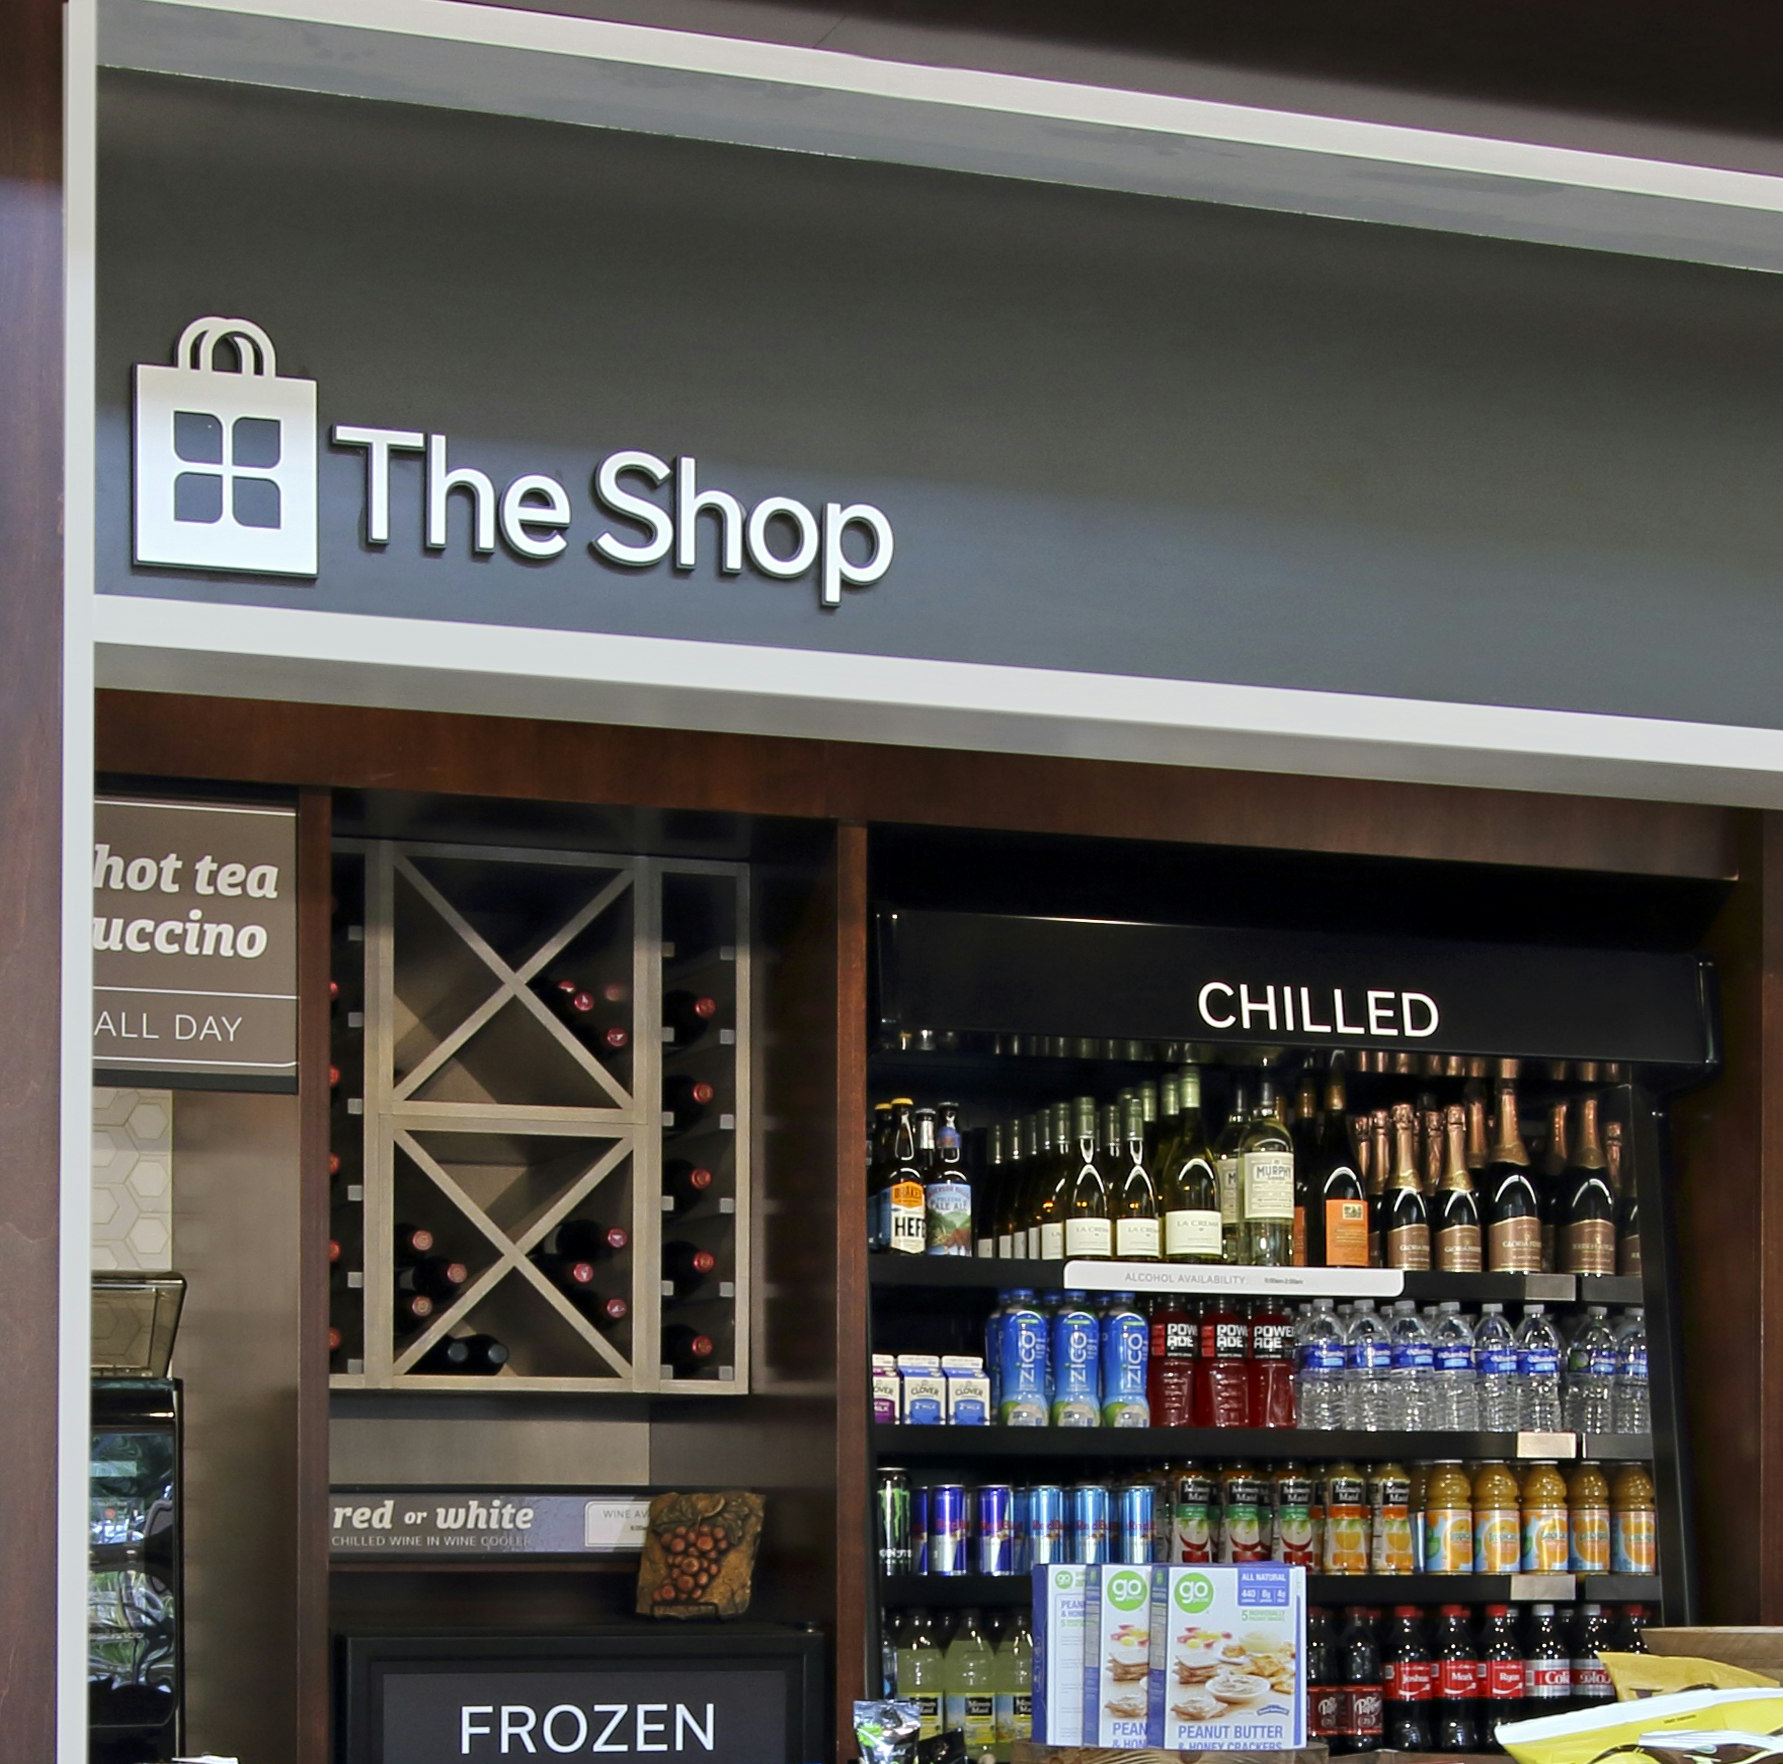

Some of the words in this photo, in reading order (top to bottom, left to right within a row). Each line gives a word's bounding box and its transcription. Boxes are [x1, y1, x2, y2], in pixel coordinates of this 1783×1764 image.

[331, 424, 571, 560] The
[592, 449, 896, 607] Shop
[93, 844, 179, 893] hot
[196, 858, 279, 899] tea
[1197, 981, 1441, 1038] CHILLED
[94, 1011, 161, 1040] ALL
[174, 1014, 243, 1043] DAY
[1125, 1272, 1175, 1284] ALCOHOL
[1176, 1273, 1247, 1286] AVAILABILITY
[1166, 1335, 1195, 1348] ADE
[1216, 1335, 1244, 1348] ADE
[1253, 1336, 1283, 1350] ADE
[1019, 1331, 1036, 1382] ZICO
[1069, 1331, 1087, 1382] ZICO
[1127, 1332, 1144, 1382] ZICO
[910, 1386, 940, 1397] CLOVER
[954, 1386, 985, 1397] CLOVER
[332, 1500, 394, 1529] red
[404, 1509, 428, 1524] or
[436, 1500, 534, 1530] white
[602, 1509, 631, 1520] WINE
[331, 1535, 386, 1547] CHILLED
[388, 1535, 423, 1547] WINE
[426, 1535, 438, 1547] IN
[441, 1535, 478, 1547] WINE
[1241, 1573, 1255, 1582] ALL
[1256, 1573, 1287, 1582] NATURAL
[1112, 1578, 1143, 1601] go
[1179, 1579, 1209, 1604] go
[1241, 1610, 1248, 1622] 5
[1499, 1672, 1520, 1684] Ryan
[460, 1703, 716, 1755] FROZEN
[1178, 1726, 1230, 1739] PEANUT
[1234, 1726, 1283, 1739] BUTTER
